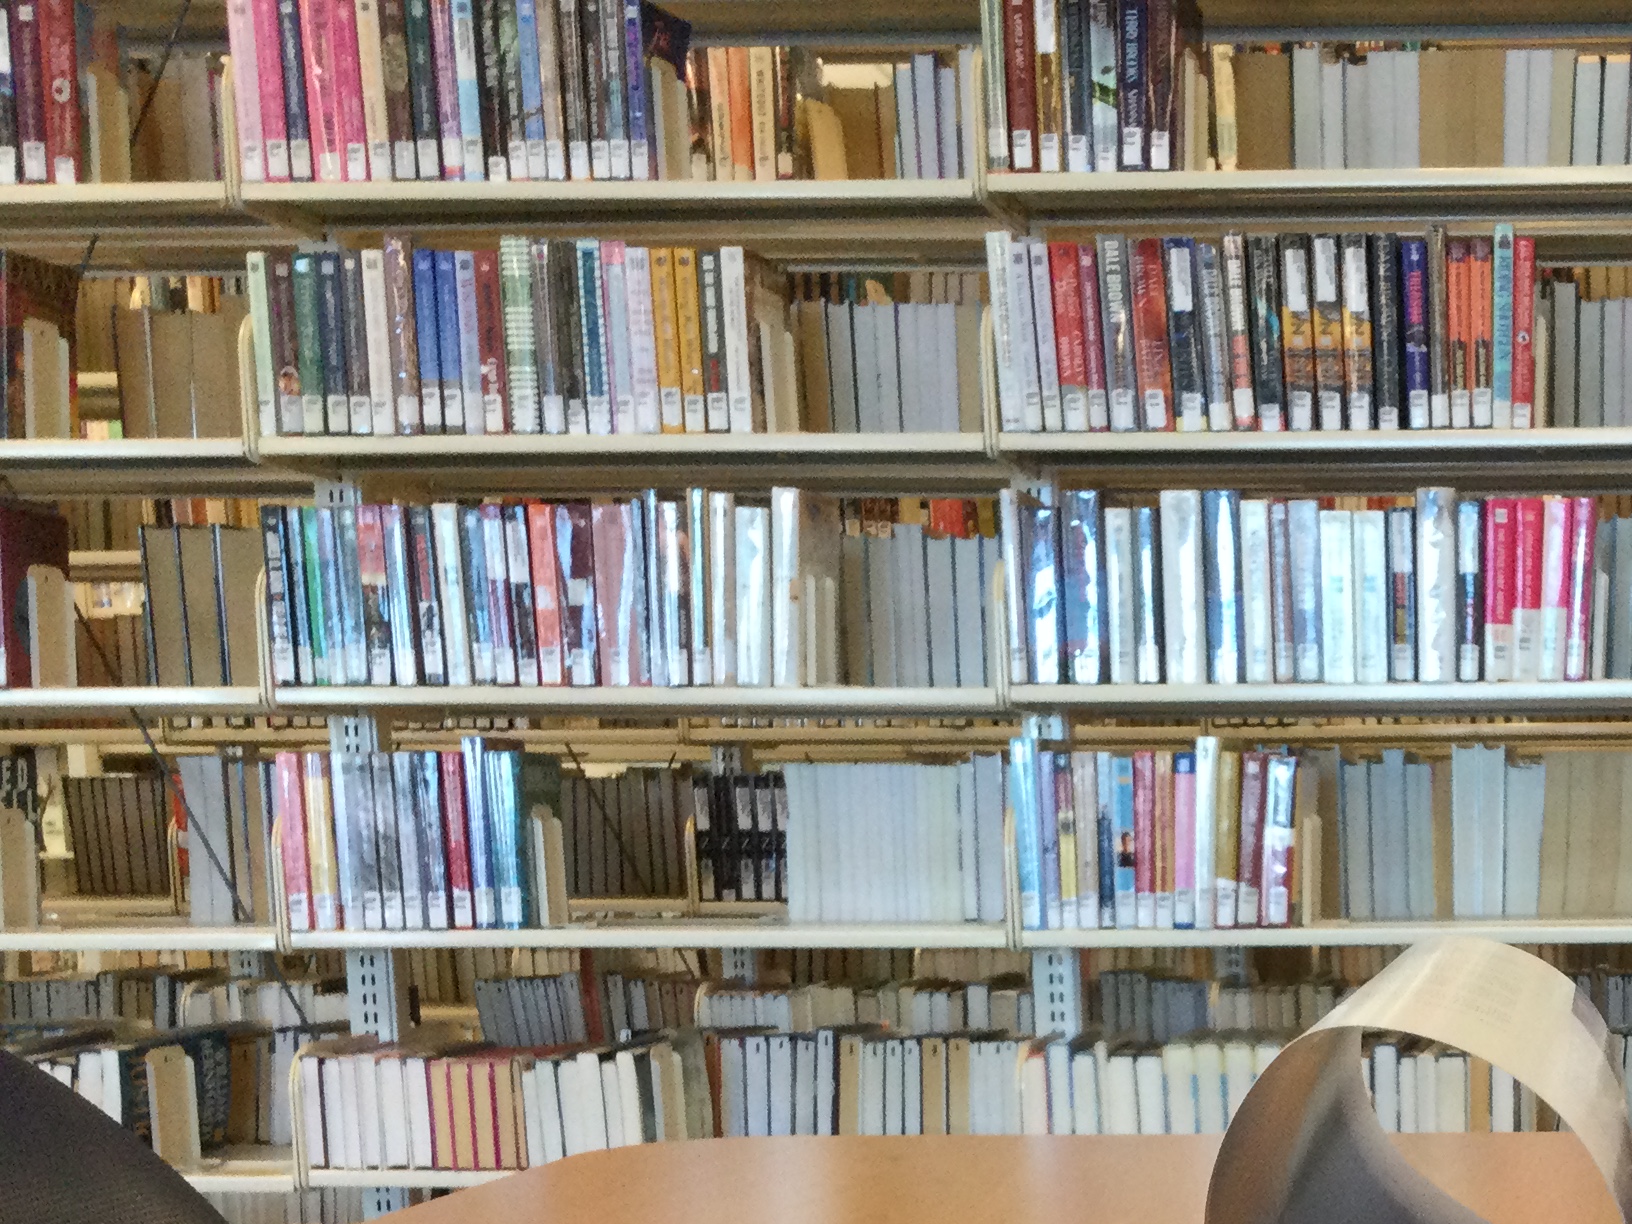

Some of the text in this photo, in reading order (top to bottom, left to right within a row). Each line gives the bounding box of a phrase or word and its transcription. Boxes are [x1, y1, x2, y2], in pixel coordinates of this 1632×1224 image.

[1104, 240, 1124, 323] DALE BROWN
[1230, 288, 1245, 331] BROWN
